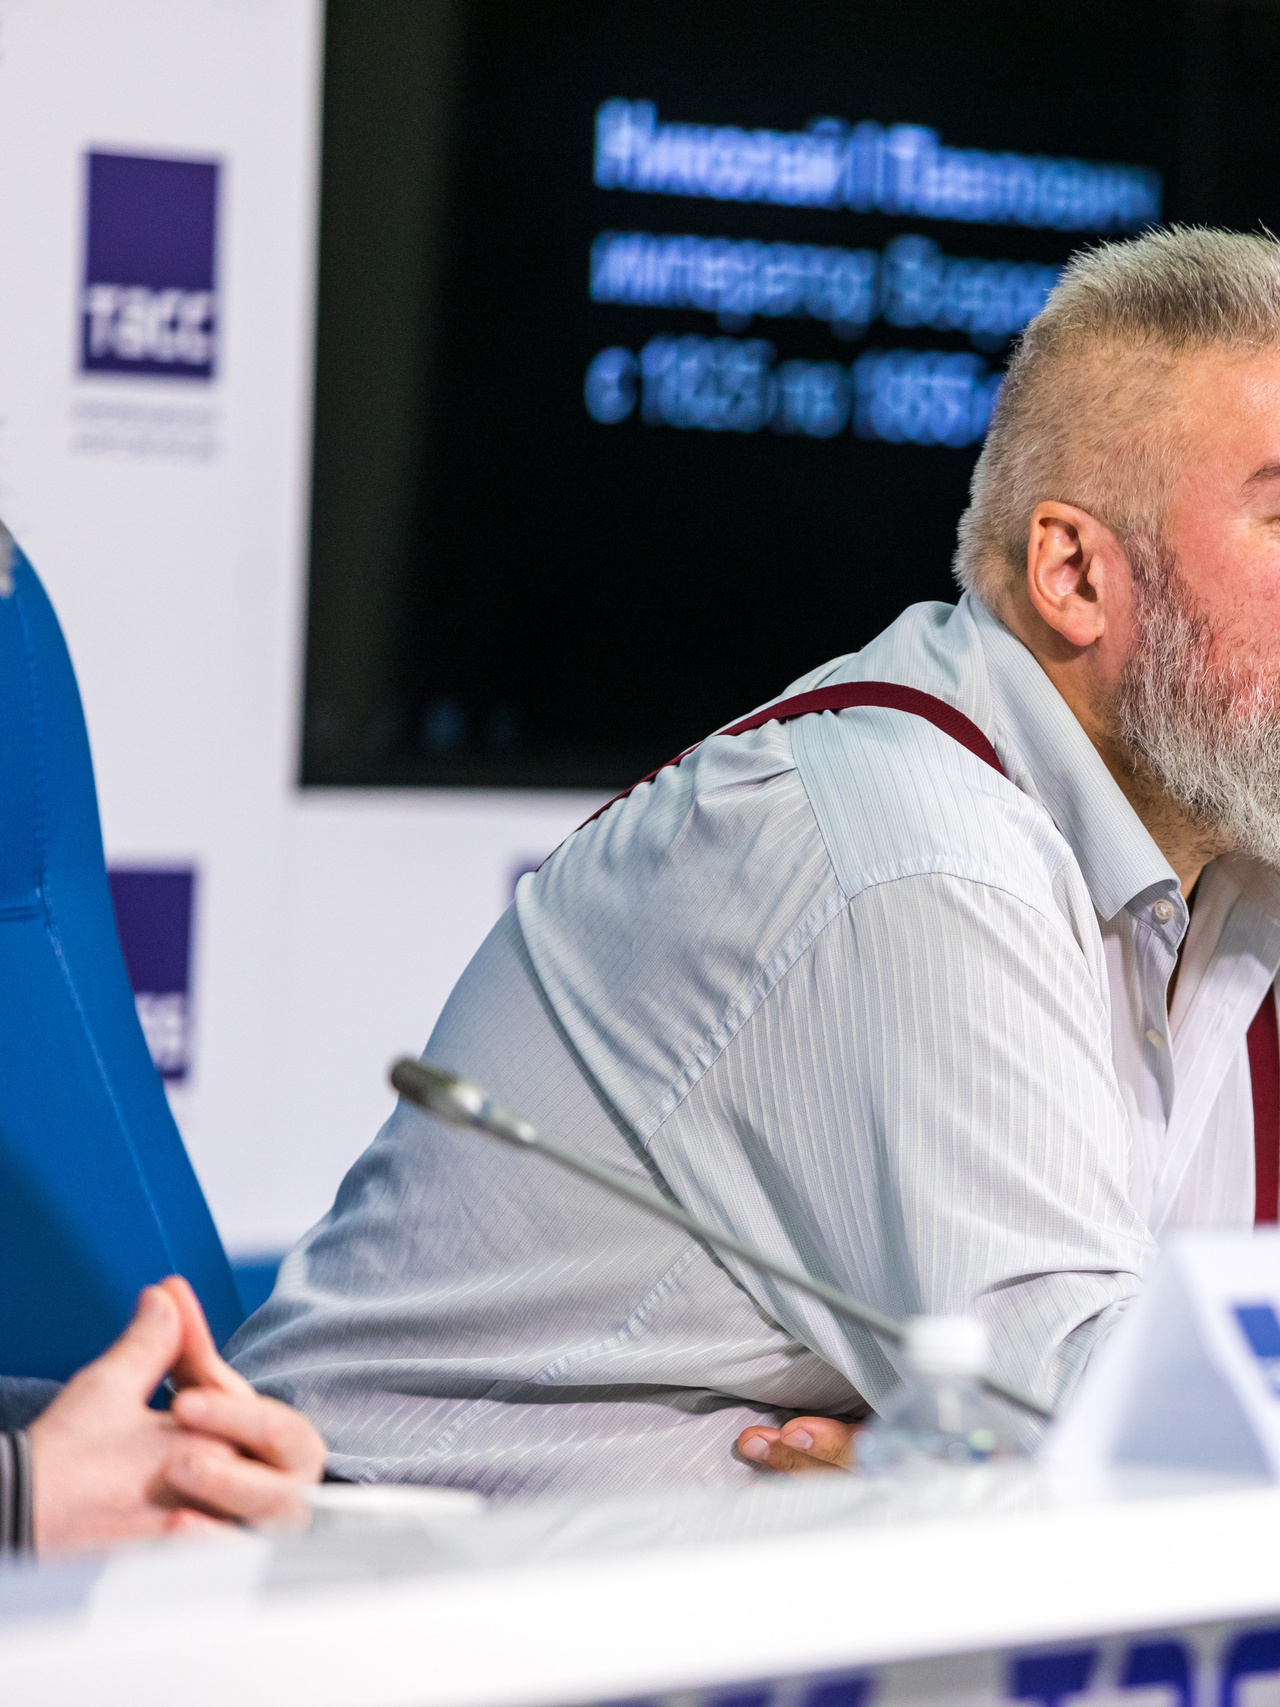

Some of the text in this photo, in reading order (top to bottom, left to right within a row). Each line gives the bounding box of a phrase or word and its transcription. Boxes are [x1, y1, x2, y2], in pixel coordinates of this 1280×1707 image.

[594, 98, 846, 208] Николай
[882, 124, 1161, 232] Павлович
[591, 231, 880, 340] император
[641, 334, 774, 432] 1825
